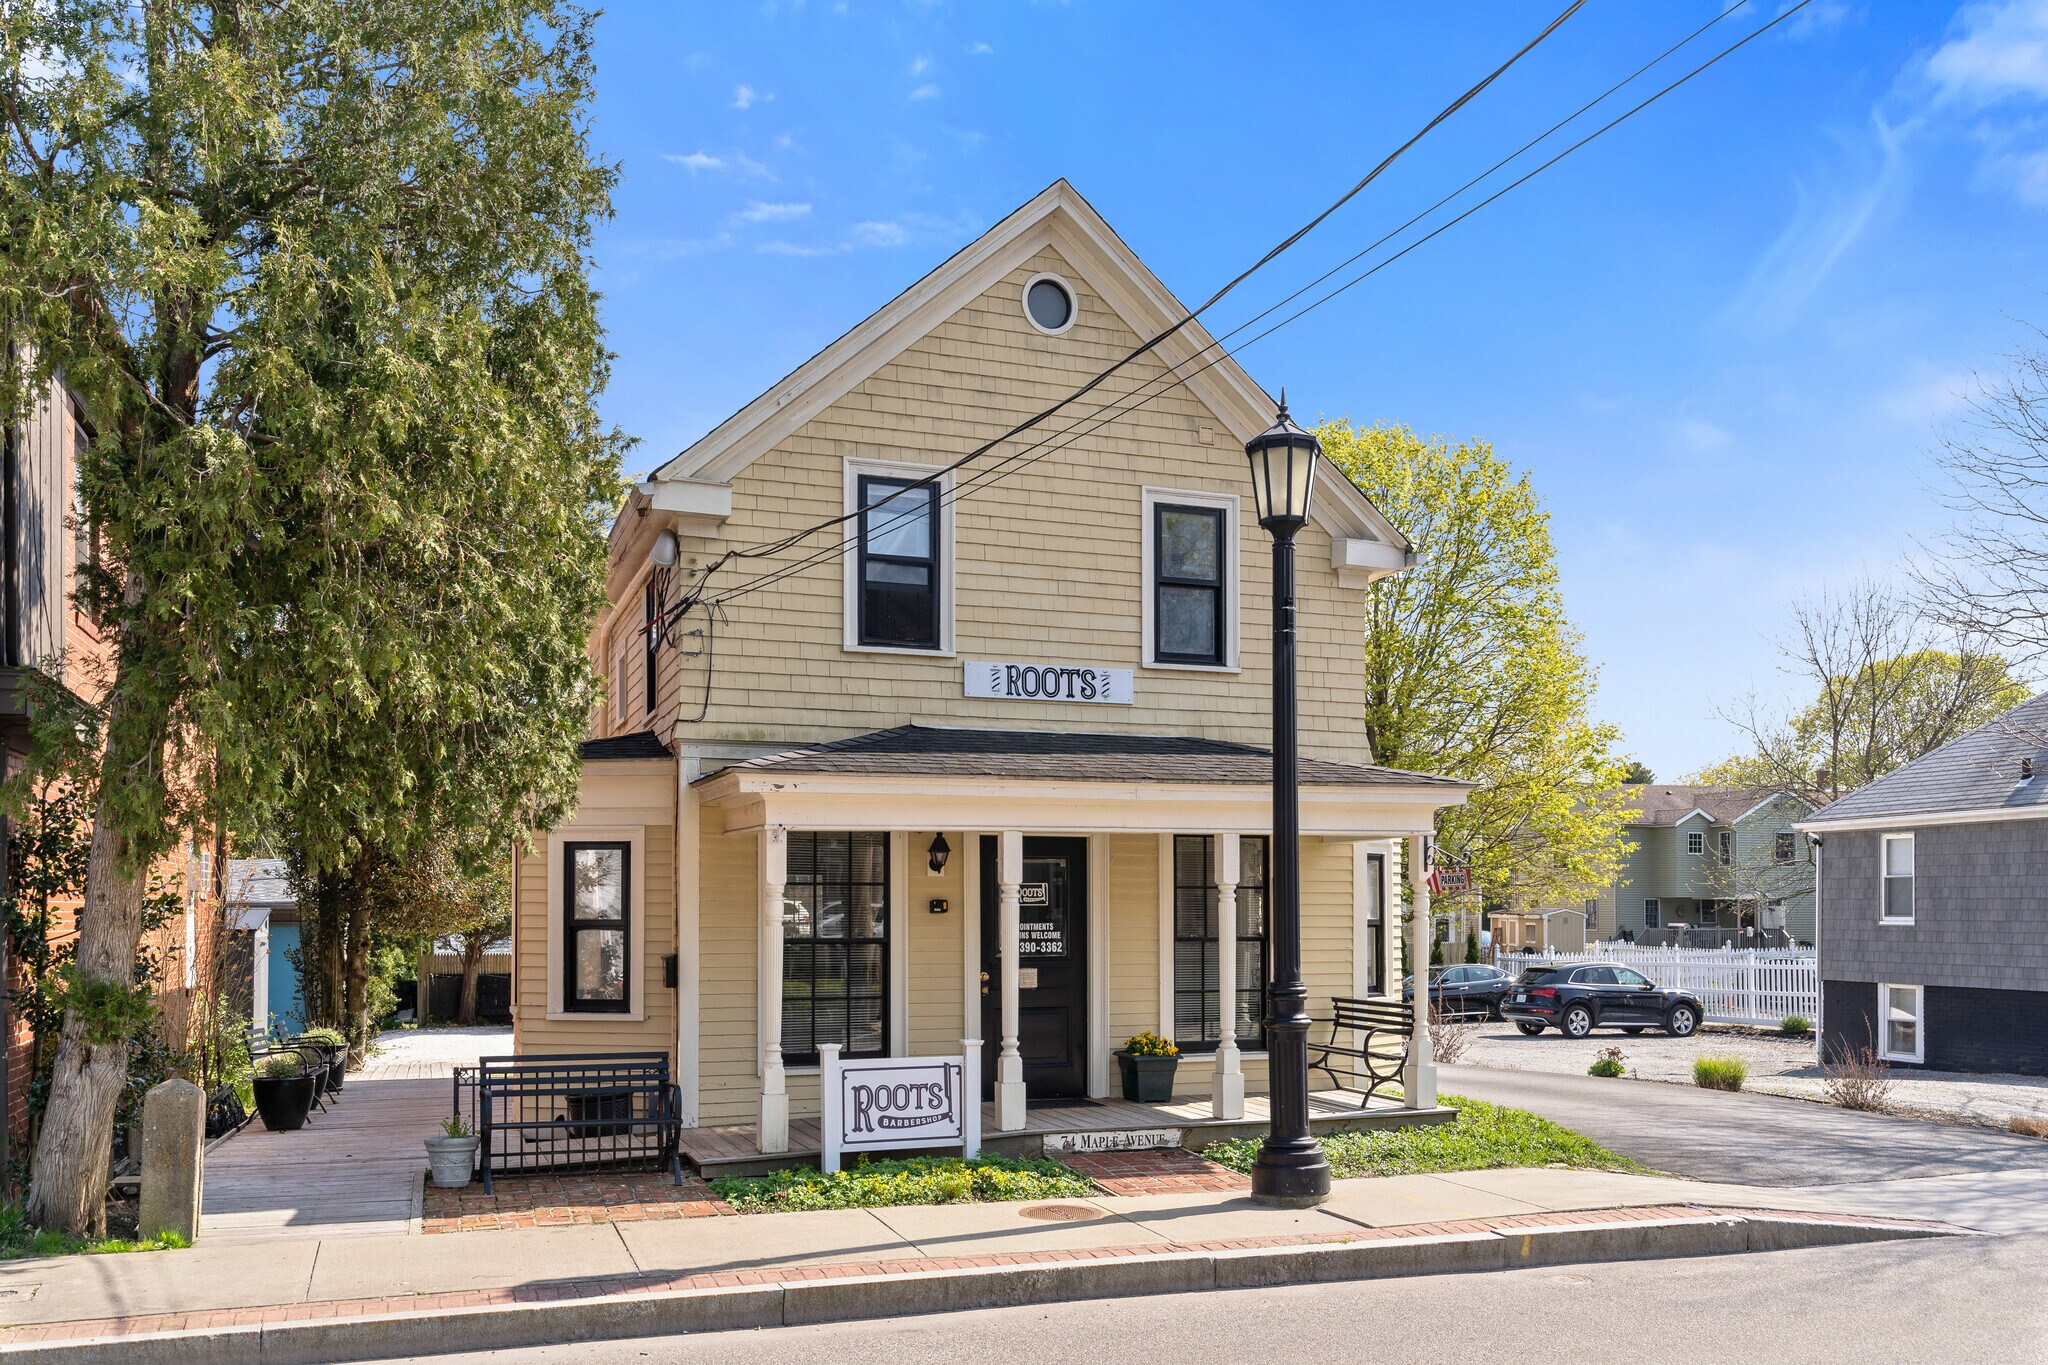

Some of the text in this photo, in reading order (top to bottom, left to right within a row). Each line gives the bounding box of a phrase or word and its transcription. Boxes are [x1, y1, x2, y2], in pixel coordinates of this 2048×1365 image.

[1005, 664, 1097, 699] ROOTS
[1441, 874, 1465, 885] PARKING
[1031, 931, 1061, 939] WELCOME
[851, 1082, 943, 1132] ROOTS
[882, 1115, 943, 1127] BARBERSHOP
[1060, 1133, 1167, 1150] 74 MAPLE AVENUE
